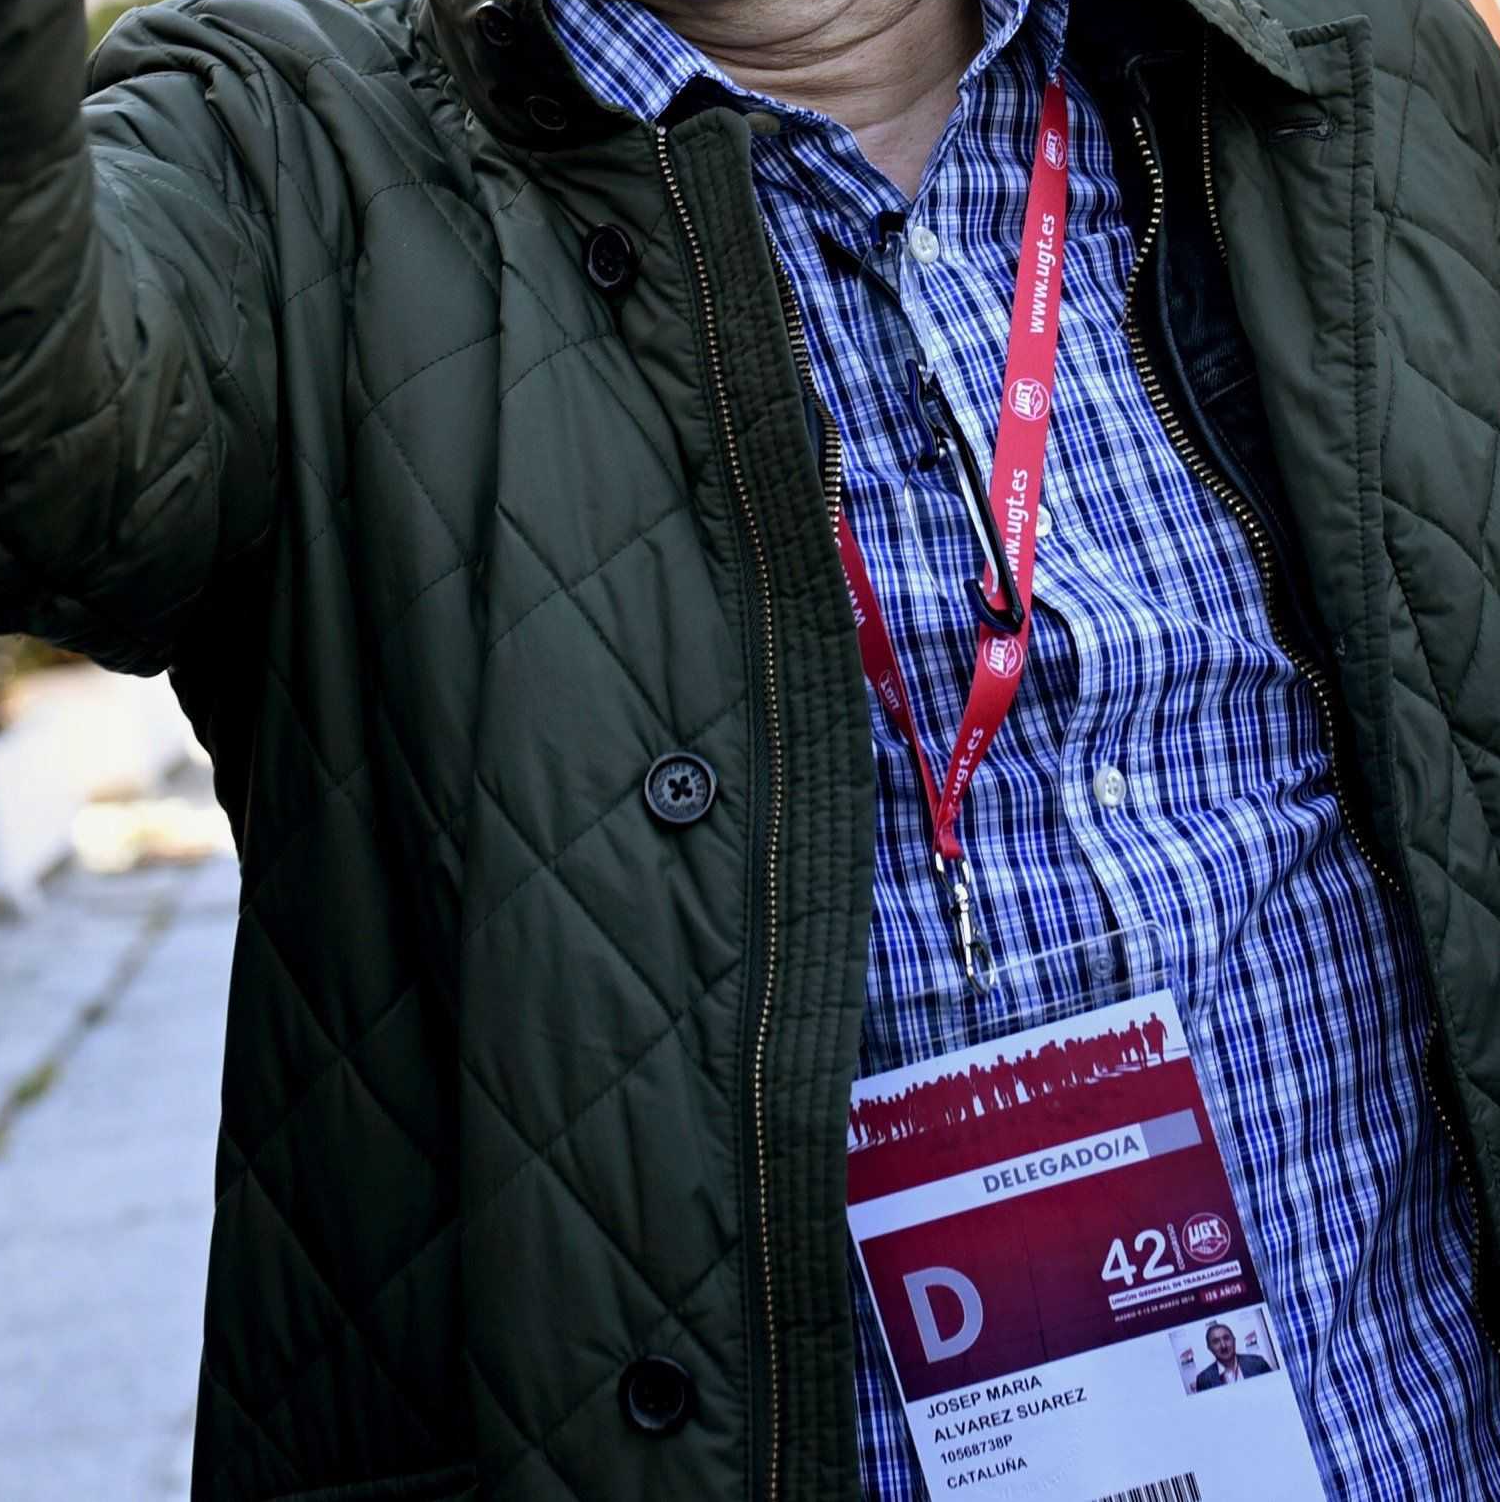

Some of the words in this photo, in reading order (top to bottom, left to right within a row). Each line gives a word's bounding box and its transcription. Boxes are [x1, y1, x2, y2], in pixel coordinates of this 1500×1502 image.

[1029, 212, 1056, 335] www.ugt.es
[1005, 468, 1031, 587] ww.ugt.es
[982, 1134, 1140, 1194] DELEGADO/A
[1101, 1228, 1175, 1286] 42
[902, 1265, 985, 1364] D
[926, 1391, 982, 1420] JOSEP
[985, 1375, 1043, 1403] MARIA
[933, 1408, 1015, 1445] ALVAREZ
[1016, 1387, 1088, 1420] SUAREZ
[946, 1456, 1028, 1490] CATALUÑA
